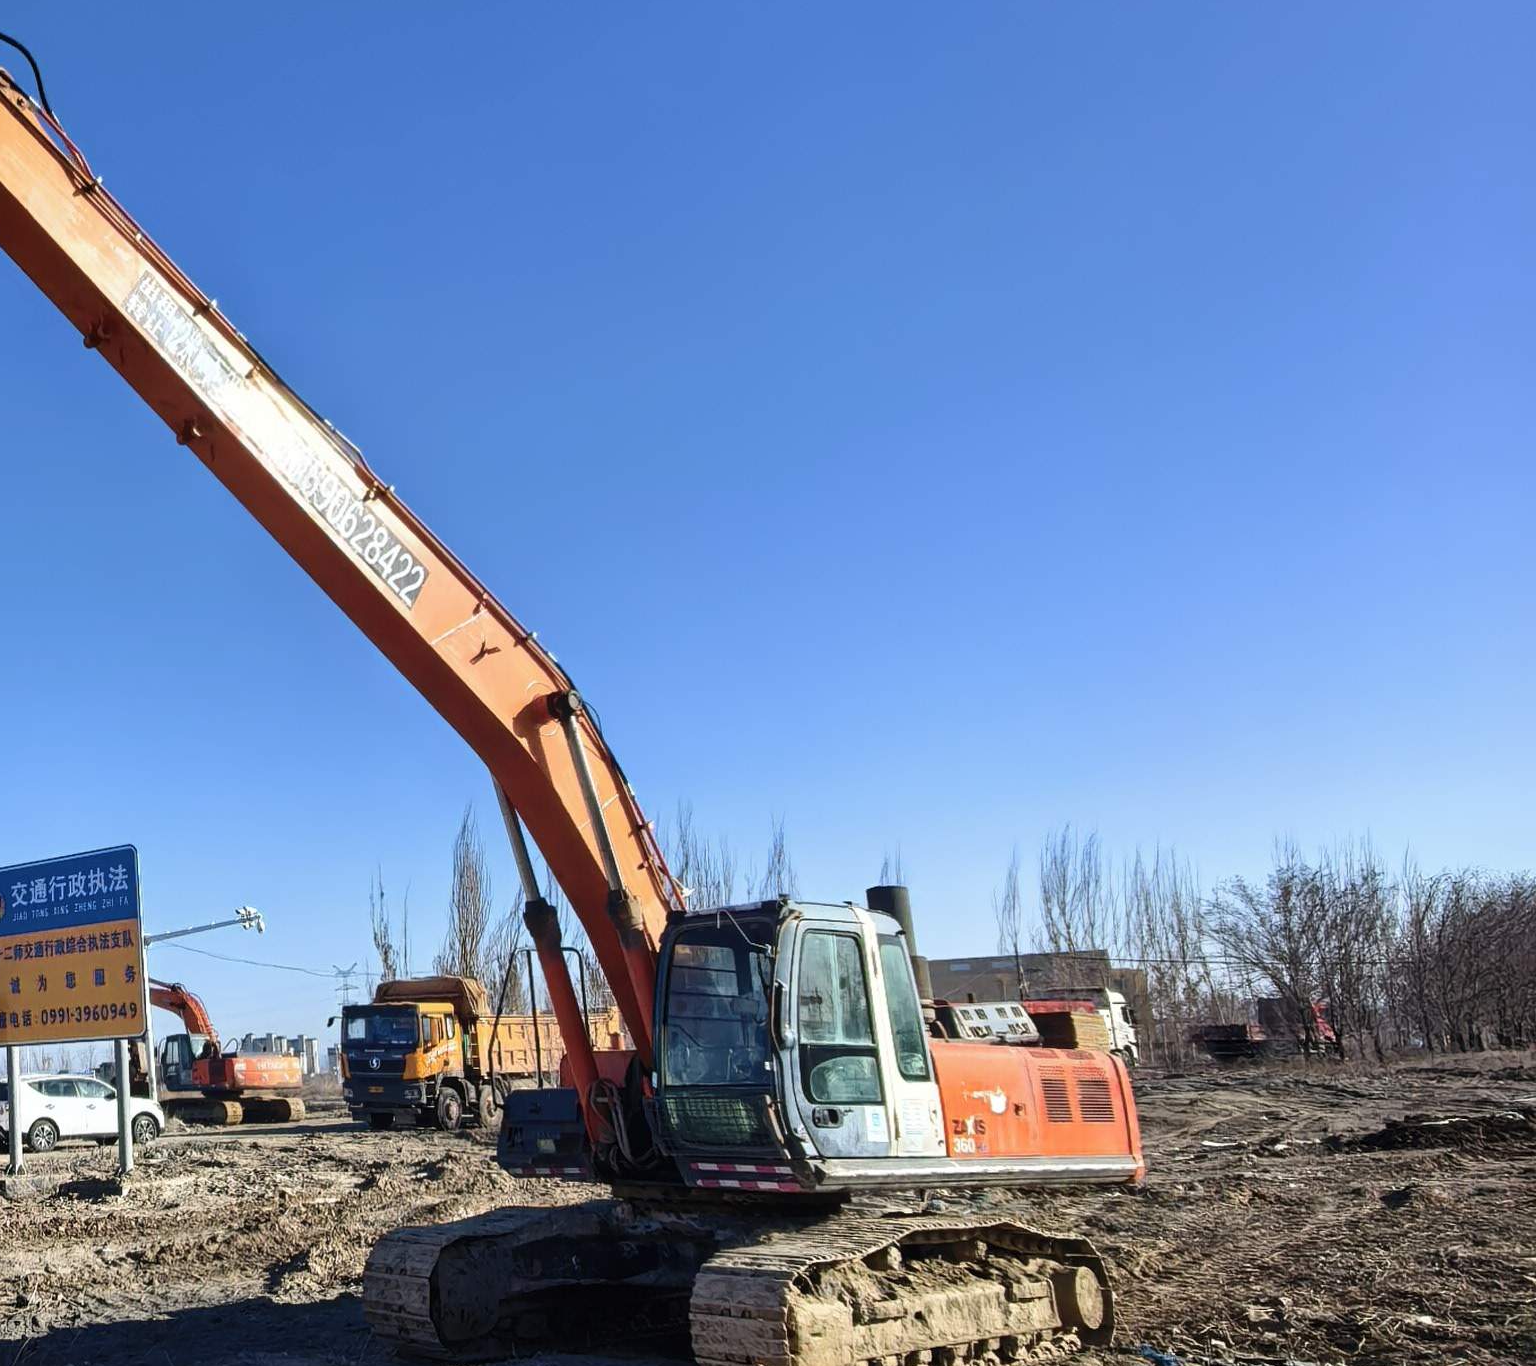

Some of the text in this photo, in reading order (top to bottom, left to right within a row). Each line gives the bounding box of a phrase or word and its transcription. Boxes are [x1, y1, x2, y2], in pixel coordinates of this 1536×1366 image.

[11, 864, 129, 908] 交通行政执法
[74, 901, 97, 912] ZHENG
[102, 898, 114, 908] ZHI
[119, 897, 129, 906] FA
[953, 1138, 975, 1153] 360
